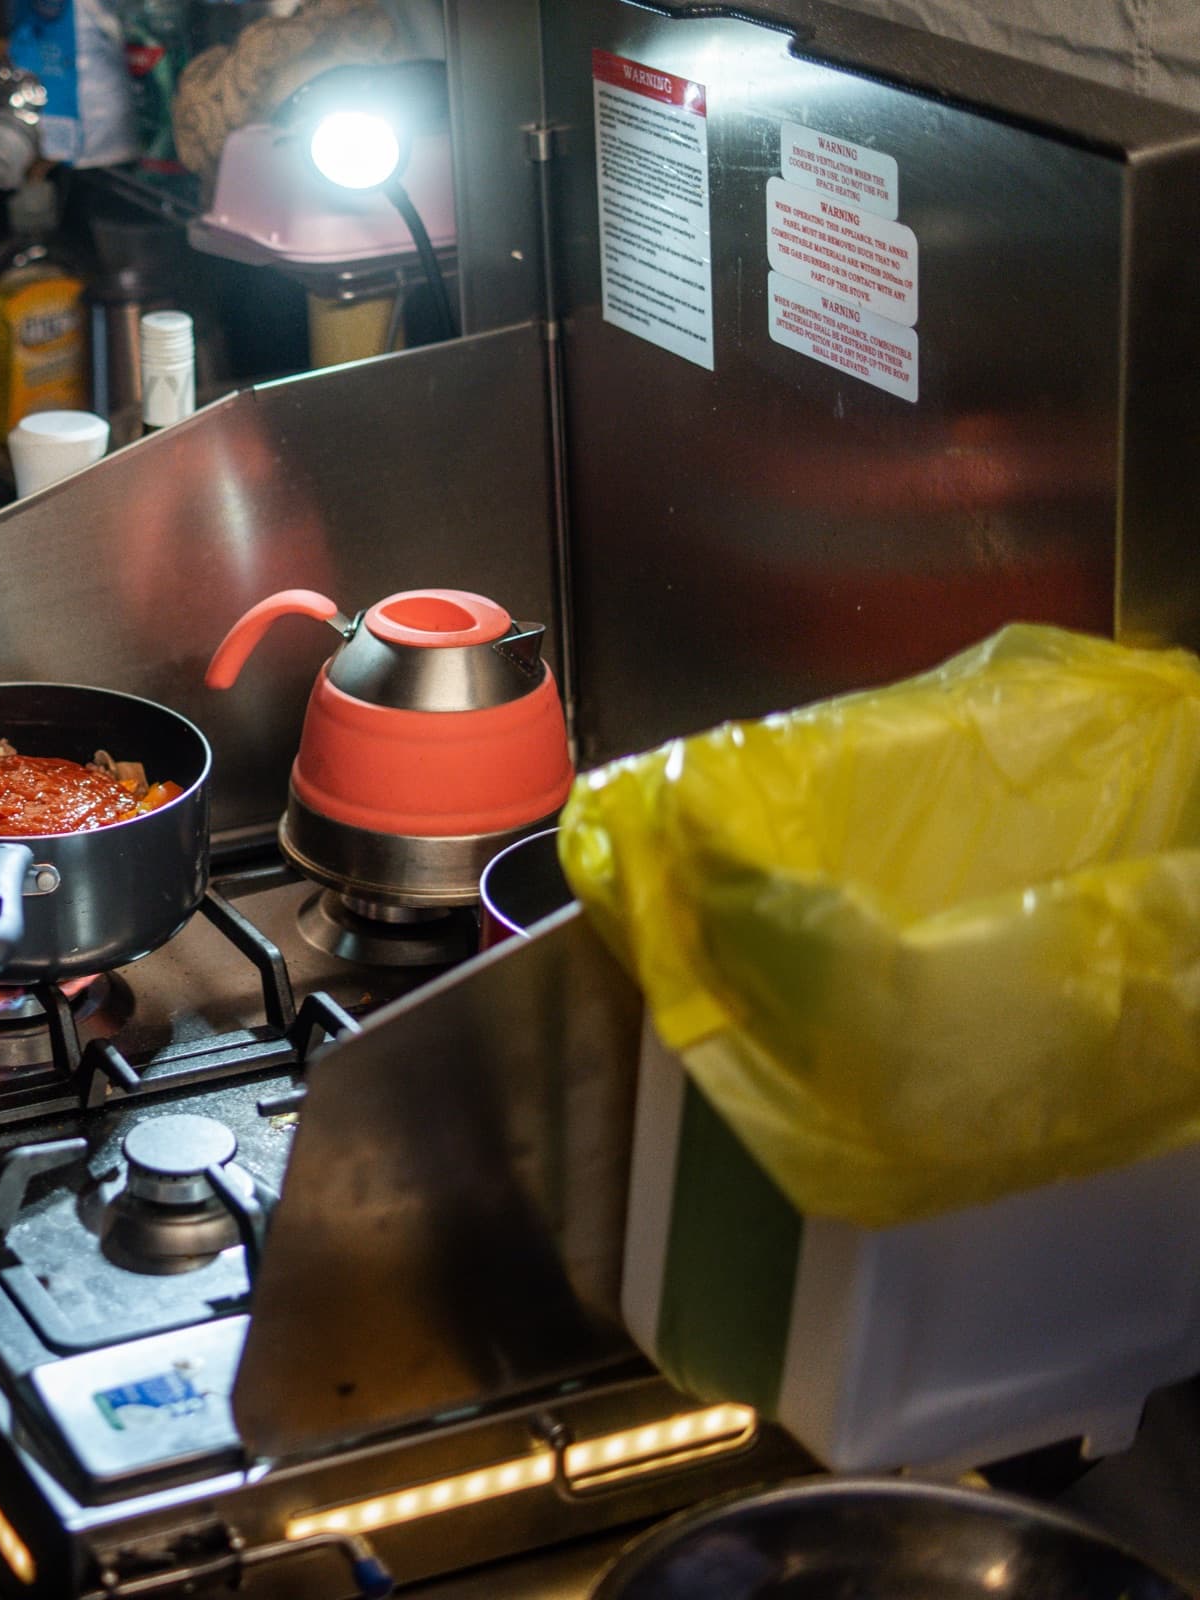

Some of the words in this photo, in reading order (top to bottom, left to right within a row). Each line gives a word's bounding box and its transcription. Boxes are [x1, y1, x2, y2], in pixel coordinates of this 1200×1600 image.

[623, 64, 672, 95] WARNING
[792, 144, 815, 161] ENSURE
[816, 153, 853, 176] VENTILATION
[853, 167, 871, 183] WHEN
[872, 174, 884, 188] THE
[818, 136, 857, 161] WARNING
[788, 154, 812, 172] COOKER
[812, 163, 819, 174] IS
[819, 166, 825, 177] IN
[841, 174, 849, 186] DO
[850, 178, 862, 191] NOT
[863, 183, 875, 196] USE
[876, 188, 888, 201] FOR
[815, 176, 834, 192] SPACE
[835, 184, 860, 202] HEATING
[775, 199, 790, 214] WHEN
[793, 207, 824, 227] OPERATING
[826, 220, 838, 233] THIS
[874, 239, 886, 252] THE
[820, 201, 860, 226] WARNING
[783, 216, 800, 231] PANEL
[801, 223, 817, 238] MUST
[818, 230, 826, 241] BE
[827, 234, 856, 253] REMOVED
[857, 246, 873, 260] SUCH
[874, 253, 889, 267] THAT
[891, 259, 899, 271] NO
[777, 242, 789, 255] THE
[790, 247, 802, 260] GAS
[803, 252, 830, 272] BURNERS
[831, 264, 840, 276] OR
[841, 268, 847, 279] IN
[848, 271, 875, 290] CONTACT
[876, 283, 892, 298] WITH
[893, 290, 905, 303] ANY
[810, 269, 825, 284] PART
[826, 276, 834, 287] OF
[835, 280, 848, 293] THE
[814, 242, 846, 263] MATERIALS
[847, 256, 858, 269] ARE
[860, 261, 880, 278] WITHIN
[904, 279, 912, 291] OF
[774, 293, 789, 308] WHEN
[790, 300, 821, 321] OPERATING
[822, 314, 835, 328] THIS
[821, 296, 860, 323] WARNING
[776, 316, 803, 336] INTENDED
[804, 328, 830, 348] POSITION
[831, 340, 842, 354] AND
[844, 346, 854, 359] ANY
[855, 351, 875, 369] POP-UP
[877, 361, 891, 376] TYPE
[893, 368, 909, 384] ROOF
[782, 307, 812, 329] MATERIALS
[813, 321, 830, 337] SHALL
[831, 329, 839, 341] BE
[840, 333, 876, 357] RESTRAINED
[877, 349, 883, 360] IN
[885, 353, 902, 369] THEIR
[812, 343, 829, 359] SHALL
[830, 351, 838, 363] BE
